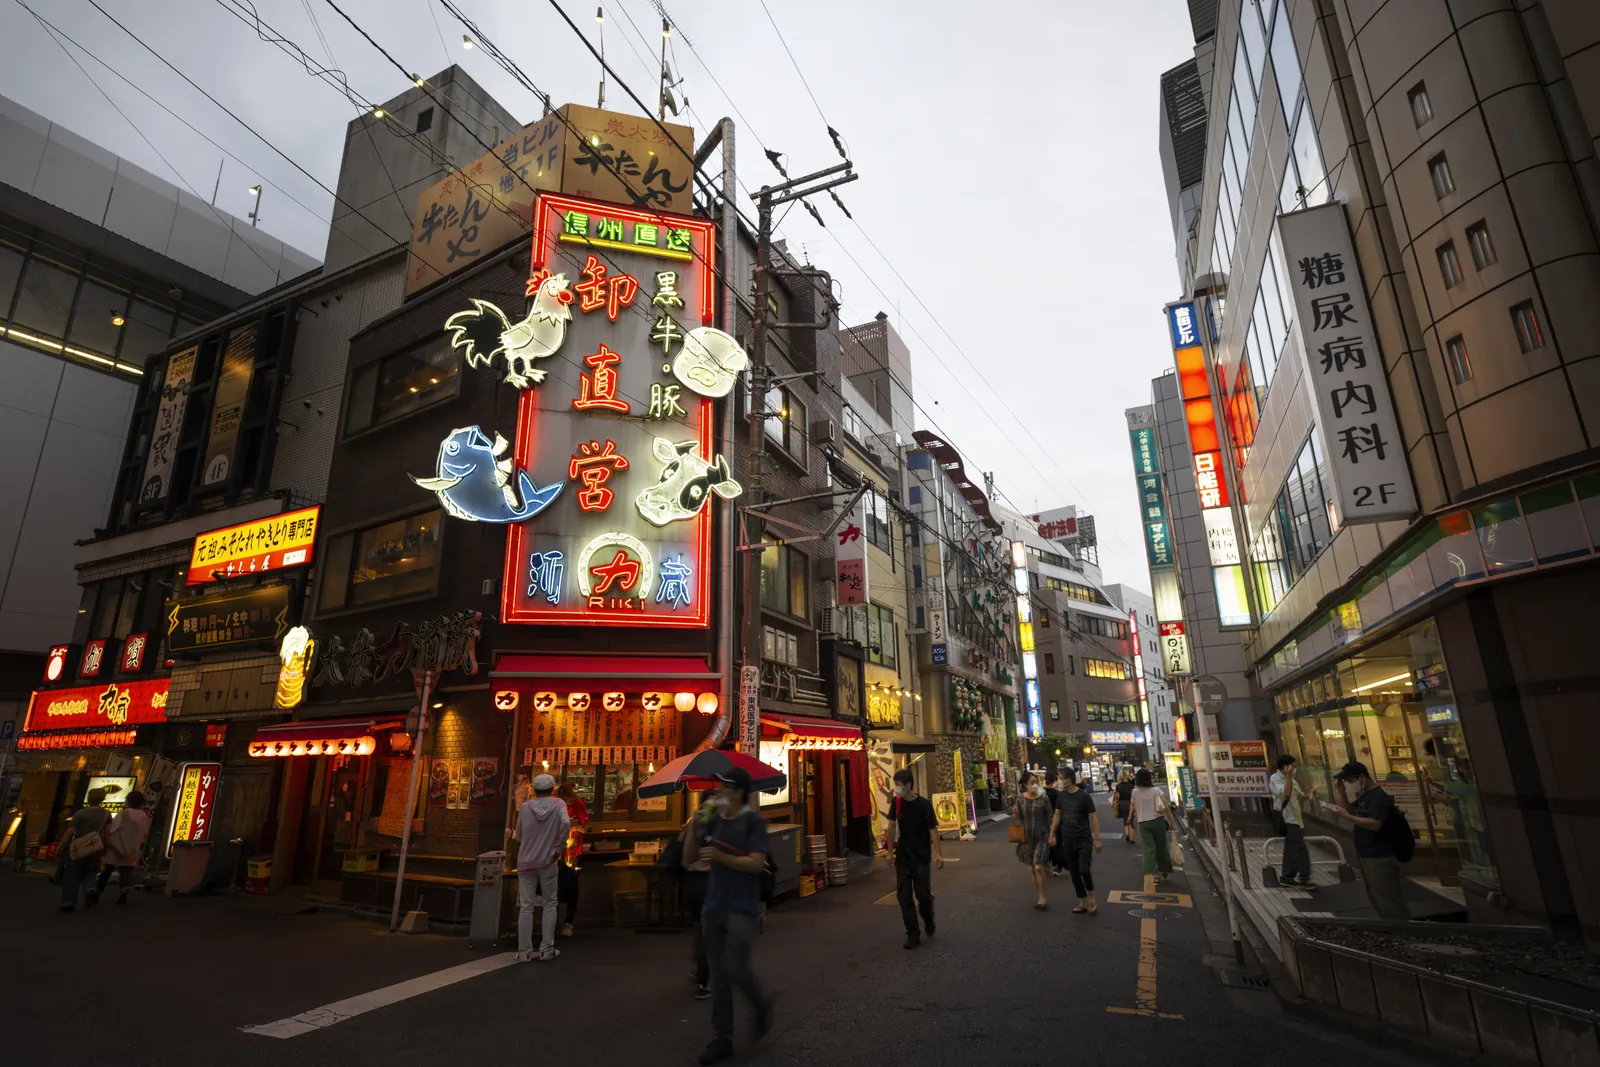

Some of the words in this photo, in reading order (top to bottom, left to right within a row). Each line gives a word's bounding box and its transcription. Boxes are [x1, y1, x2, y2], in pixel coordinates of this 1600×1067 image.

[502, 120, 560, 169] 当ビル
[563, 209, 693, 253] 信州直送
[1298, 252, 1389, 465] 糖尿病内科
[1144, 478, 1161, 518] 河合塾
[1195, 453, 1221, 507] 日能研
[1352, 483, 1397, 507] 2F
[197, 517, 315, 563] 元祖みそたれやきとり専門店
[1150, 523, 1168, 563] マナビス
[588, 596, 646, 610] RIKI
[933, 614, 942, 640] ラーメン
[1217, 775, 1265, 784] 糖尿病内科
